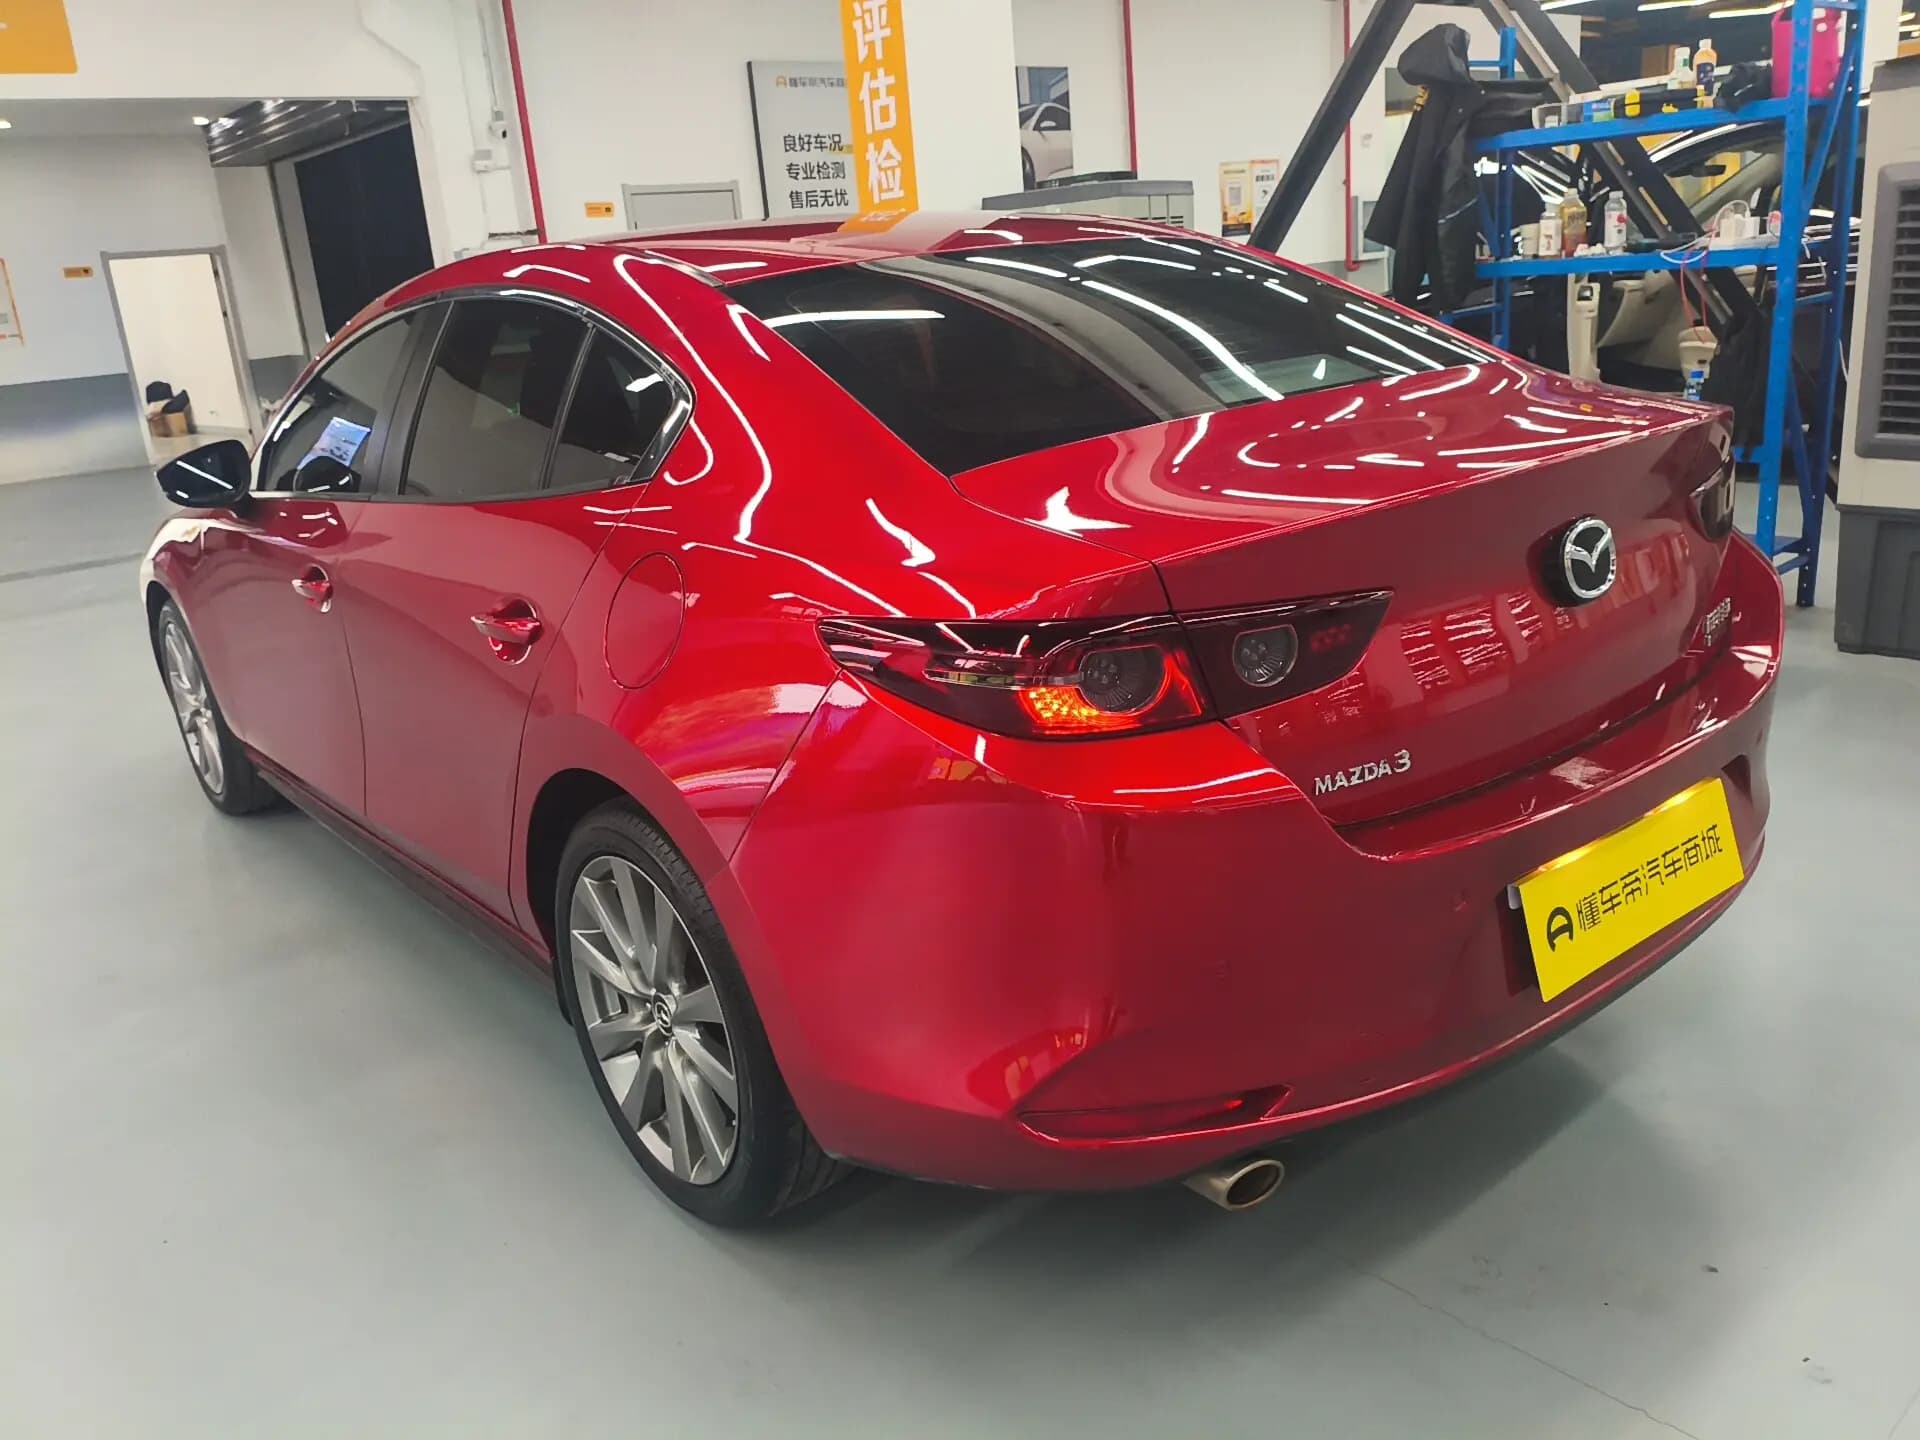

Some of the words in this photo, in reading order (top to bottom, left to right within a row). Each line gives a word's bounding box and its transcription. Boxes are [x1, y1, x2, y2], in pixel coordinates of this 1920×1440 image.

[783, 134, 844, 153] 良好车况
[786, 161, 846, 181] 专业检测
[789, 188, 849, 209] 售后无忧
[1576, 824, 1723, 931] 懂车帝汽车商城
